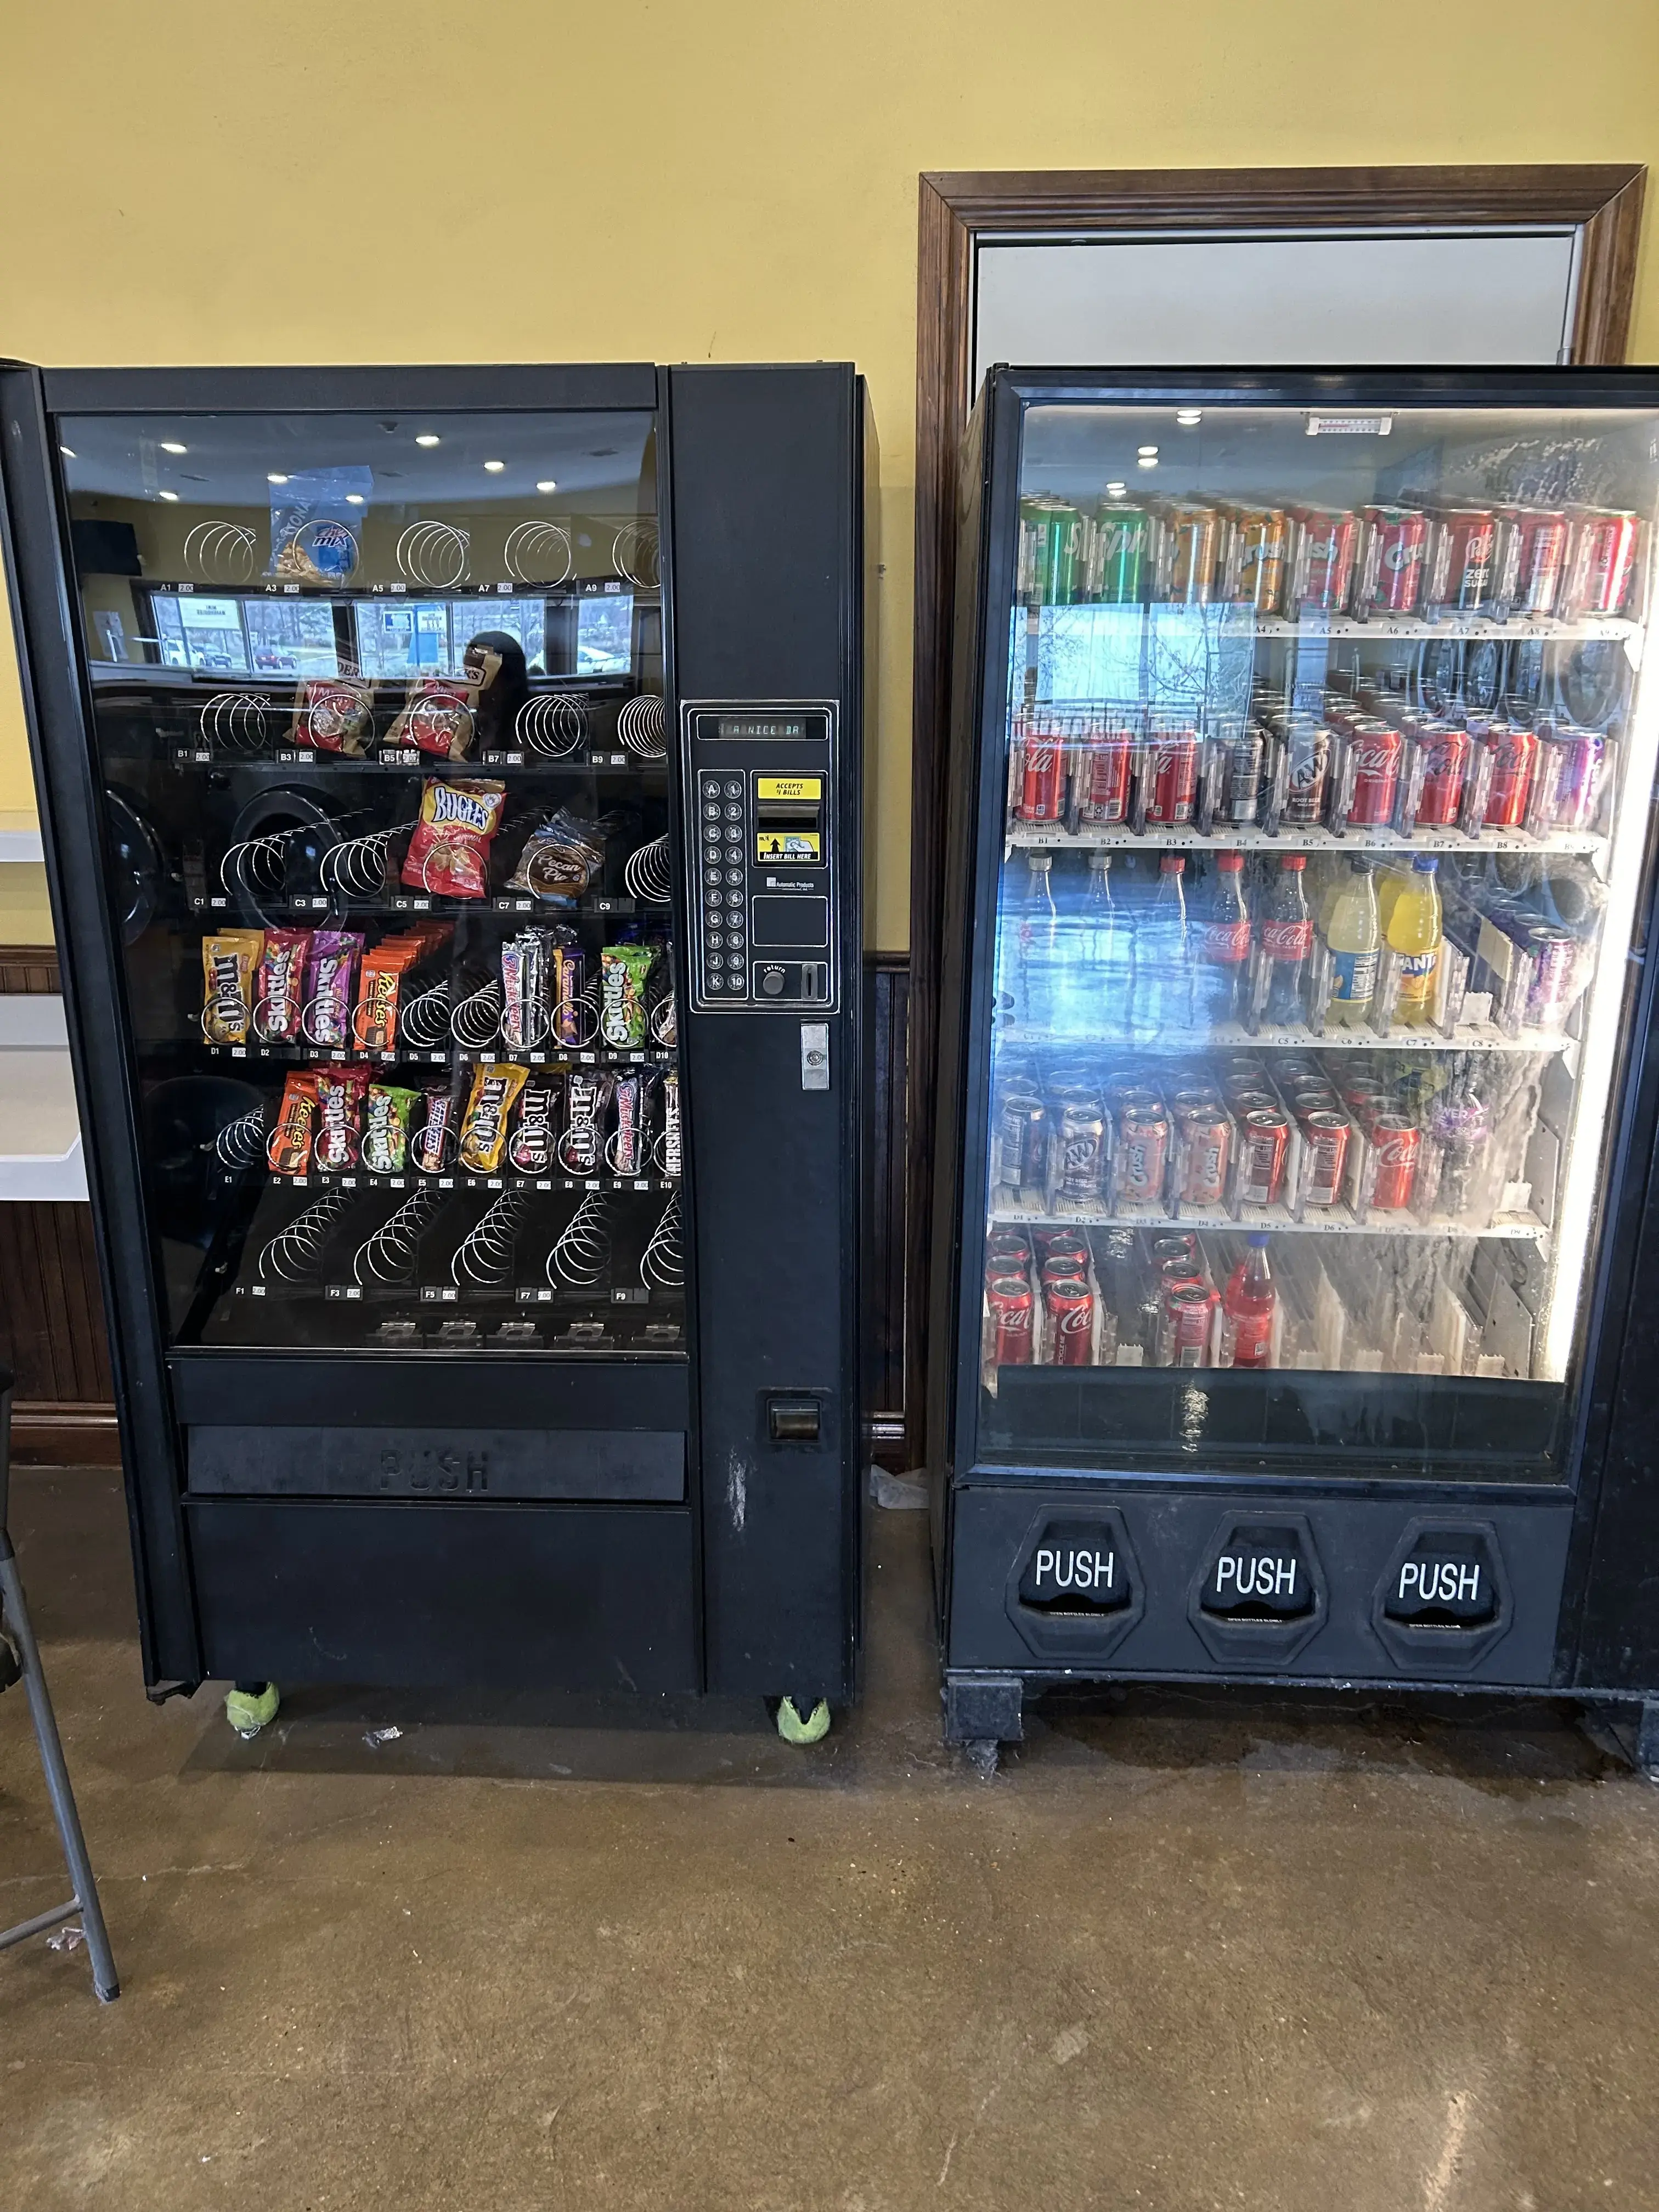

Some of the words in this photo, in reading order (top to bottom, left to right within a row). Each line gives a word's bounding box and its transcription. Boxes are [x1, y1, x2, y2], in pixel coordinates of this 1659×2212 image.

[312, 535, 348, 548] mix
[733, 726, 740, 735] A
[748, 726, 776, 735] NICE
[708, 785, 715, 794] A
[731, 786, 735, 795] 1
[434, 786, 489, 831] BUGLES
[709, 808, 715, 816] B
[731, 807, 736, 816] 2
[709, 829, 716, 838] C
[710, 851, 716, 859] D
[731, 851, 737, 859] 4
[538, 854, 582, 872] Pecan
[710, 872, 716, 881] E
[732, 872, 738, 881] 5
[712, 894, 717, 902] F
[396, 900, 407, 909] C5
[711, 915, 718, 923] G
[712, 936, 719, 944] H
[733, 936, 738, 944] 8
[763, 964, 786, 974] return
[380, 1449, 488, 1492] PUSH
[1036, 1550, 1114, 1588] PUSH
[1216, 1556, 1296, 1594] PUSH
[1399, 1562, 1480, 1600] PUSH
